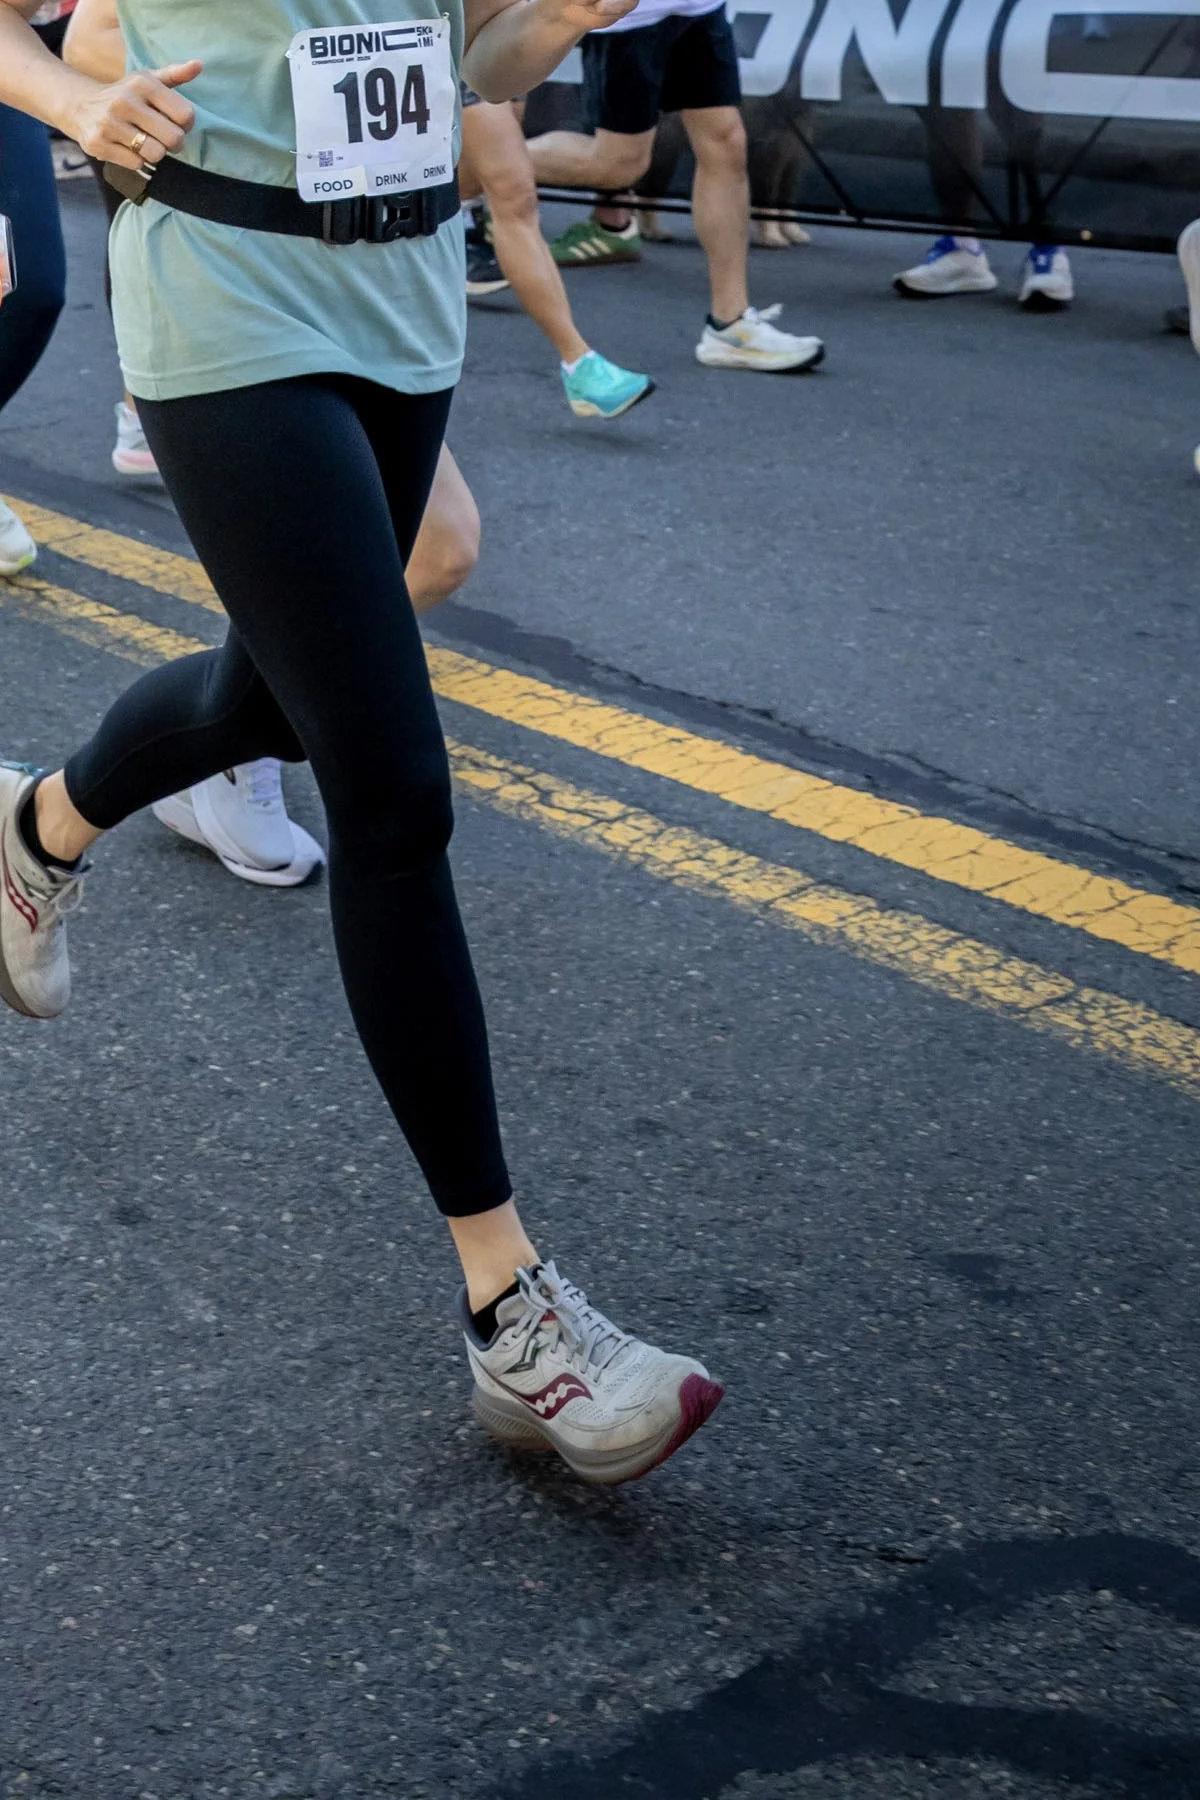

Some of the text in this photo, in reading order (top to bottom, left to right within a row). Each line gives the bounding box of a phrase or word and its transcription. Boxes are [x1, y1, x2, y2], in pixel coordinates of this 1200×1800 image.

[309, 27, 418, 58] BIONIC
[333, 64, 430, 143] 194
[314, 164, 447, 193] FOOD DRINK DRINK
